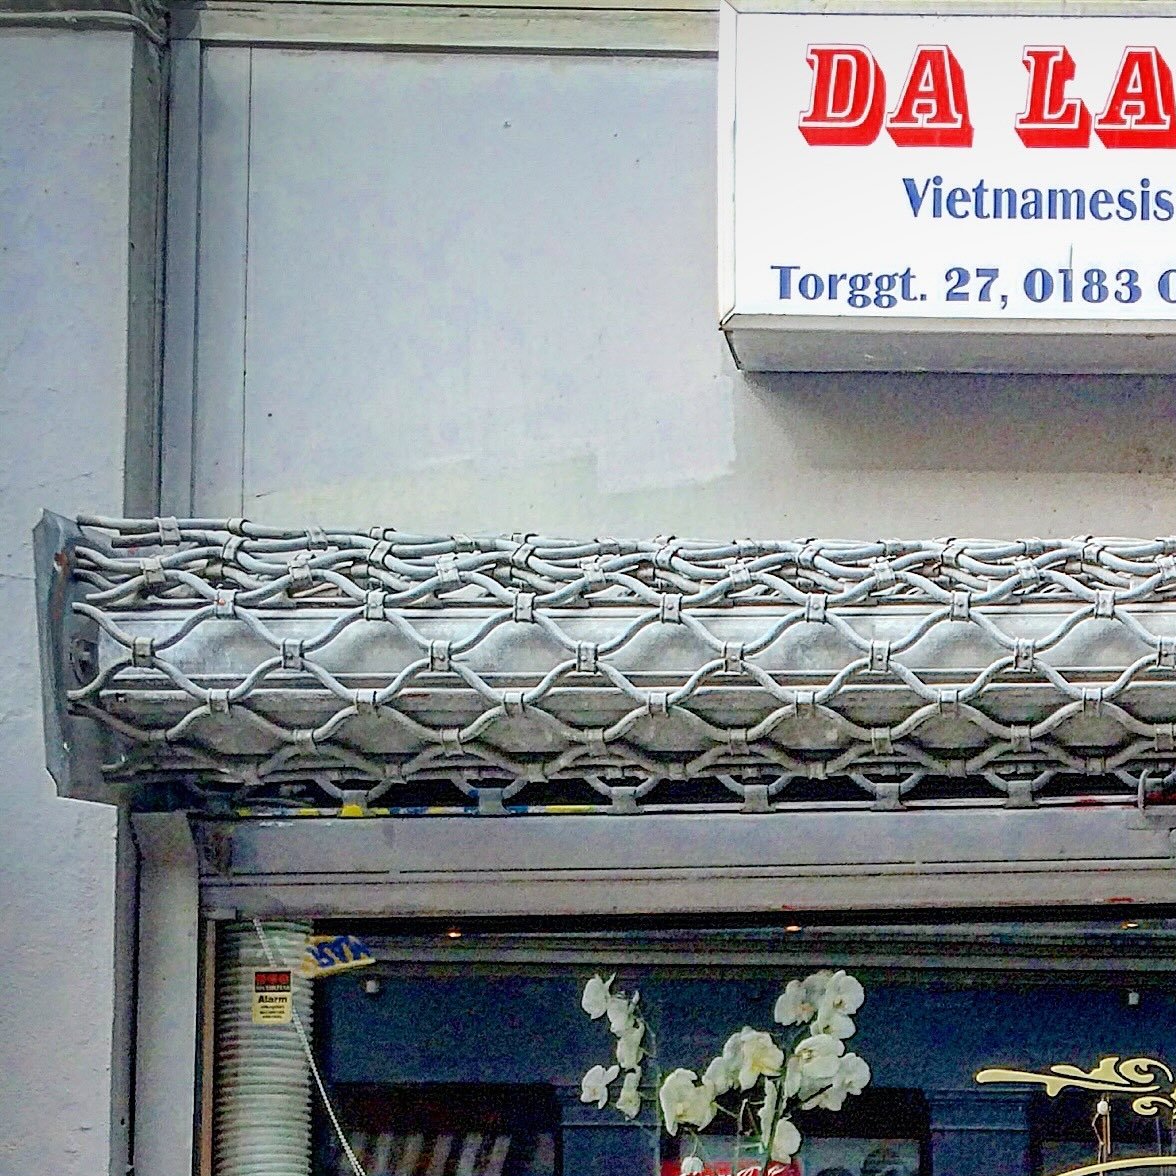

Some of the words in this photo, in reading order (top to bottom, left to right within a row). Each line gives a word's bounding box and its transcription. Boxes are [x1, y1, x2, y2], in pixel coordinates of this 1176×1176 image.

[798, 43, 974, 149] DA
[770, 264, 928, 308] Torggt.
[945, 267, 1008, 310] 27,
[1023, 266, 1142, 304] 0183
